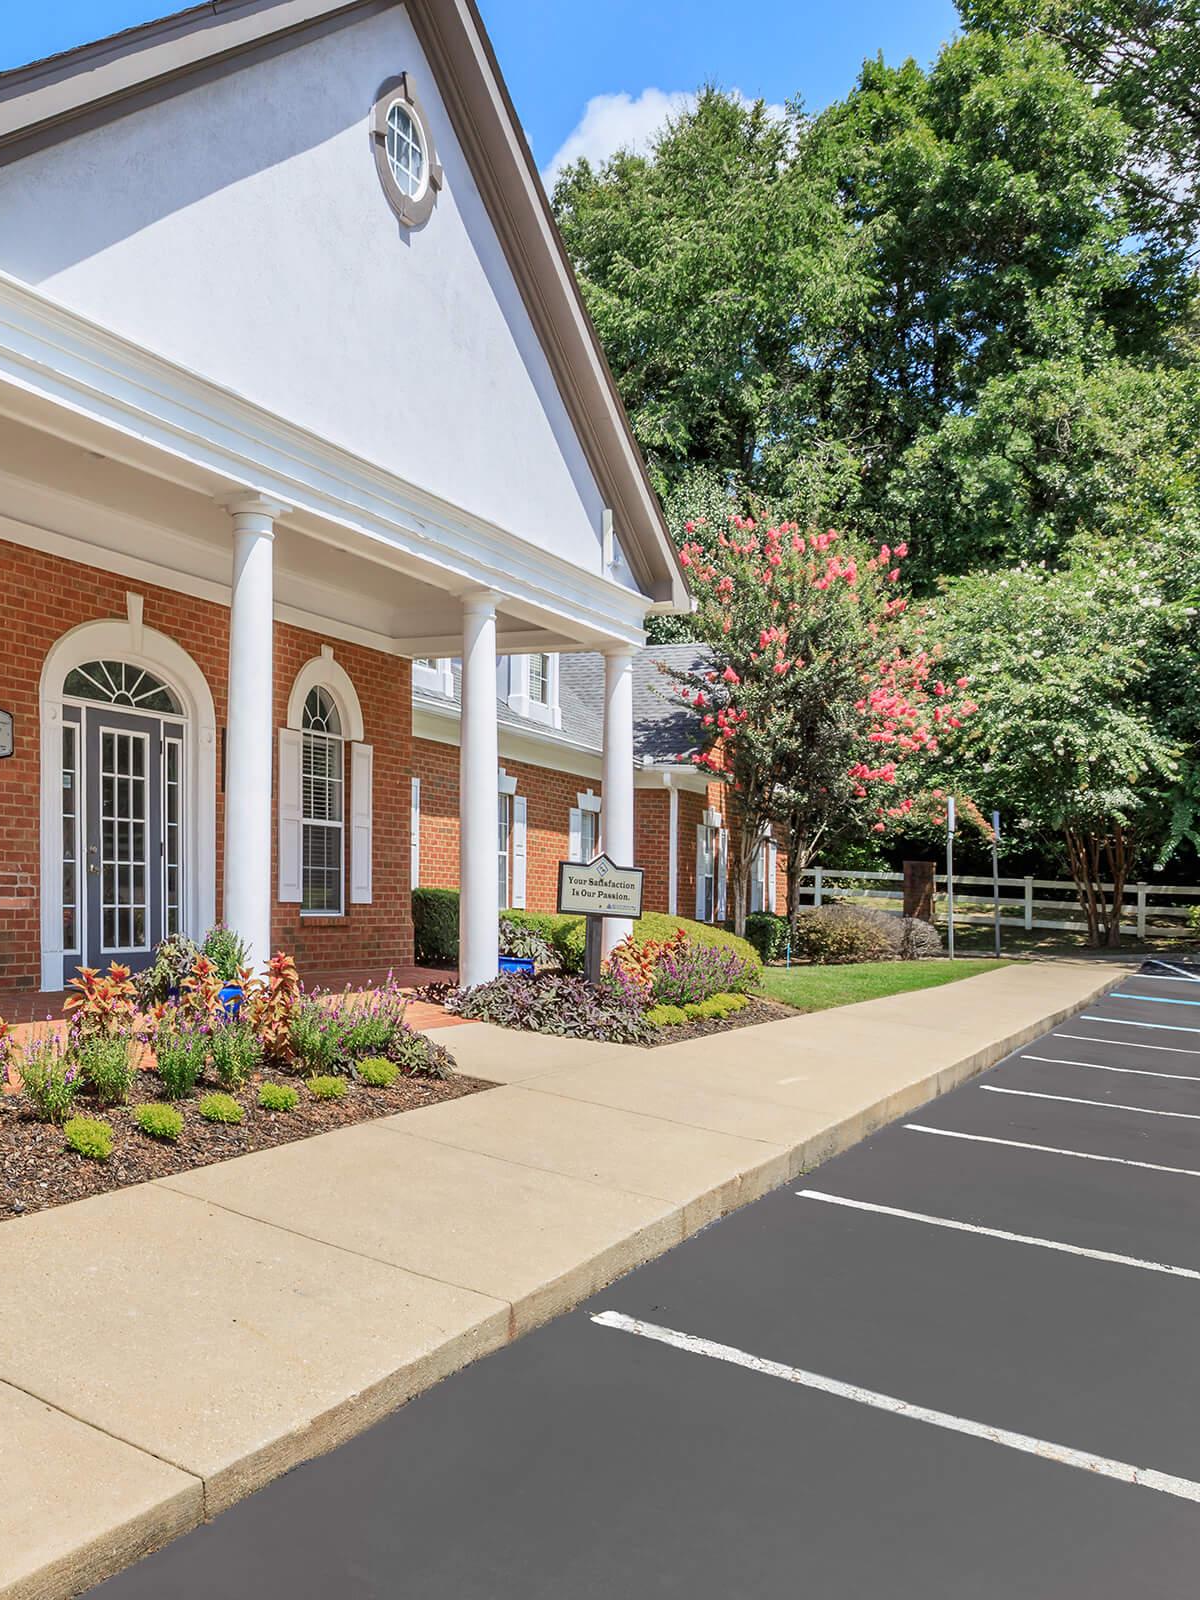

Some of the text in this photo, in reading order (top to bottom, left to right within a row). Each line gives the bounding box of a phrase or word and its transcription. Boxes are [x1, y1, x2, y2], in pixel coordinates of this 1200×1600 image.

[568, 876, 636, 890] Your Satisfaction
[571, 888, 631, 901] Is Our Passion.
